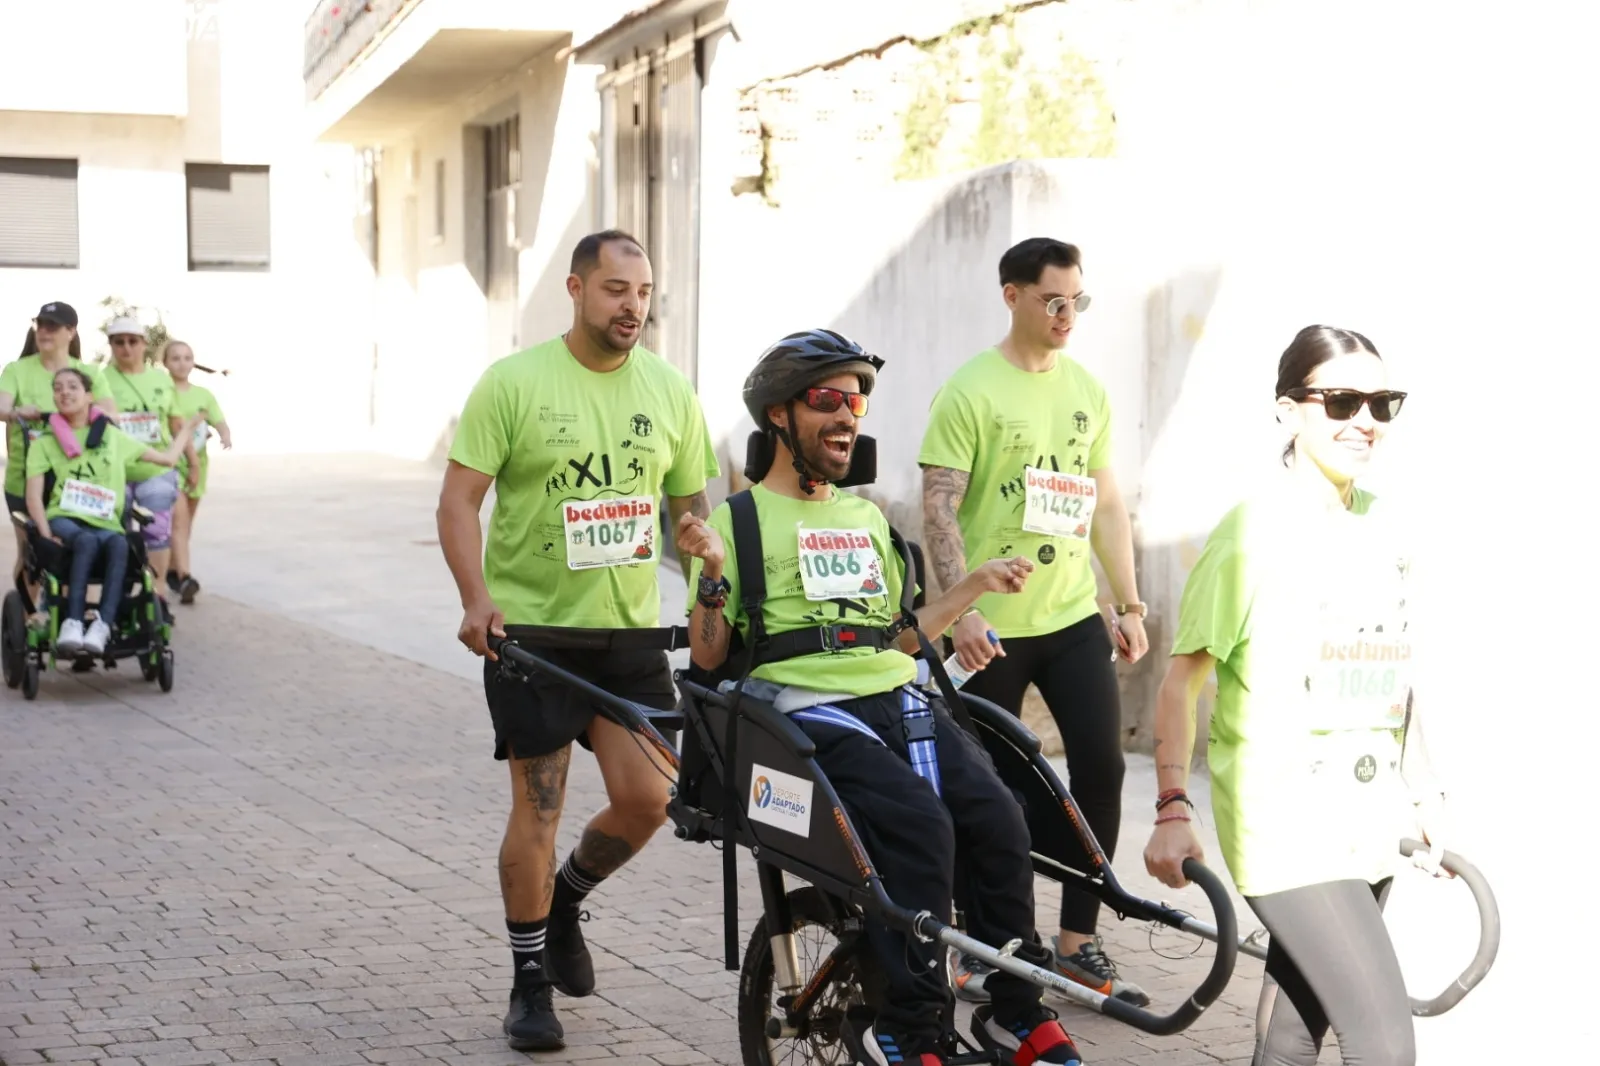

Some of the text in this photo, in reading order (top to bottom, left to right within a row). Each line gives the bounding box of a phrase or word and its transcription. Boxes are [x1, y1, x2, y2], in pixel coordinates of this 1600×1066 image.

[632, 443, 655, 454] Unicaja
[568, 451, 612, 488] XI
[1027, 472, 1096, 498] bedunia
[566, 501, 652, 523] bedunia
[1040, 494, 1084, 519] 1442
[585, 520, 637, 547] 1067
[802, 551, 861, 578] 1066
[1320, 639, 1412, 662] bedunia
[1337, 667, 1396, 699] 1068
[771, 797, 805, 813] ADAPTADO
[772, 786, 801, 803] DEPORTE
